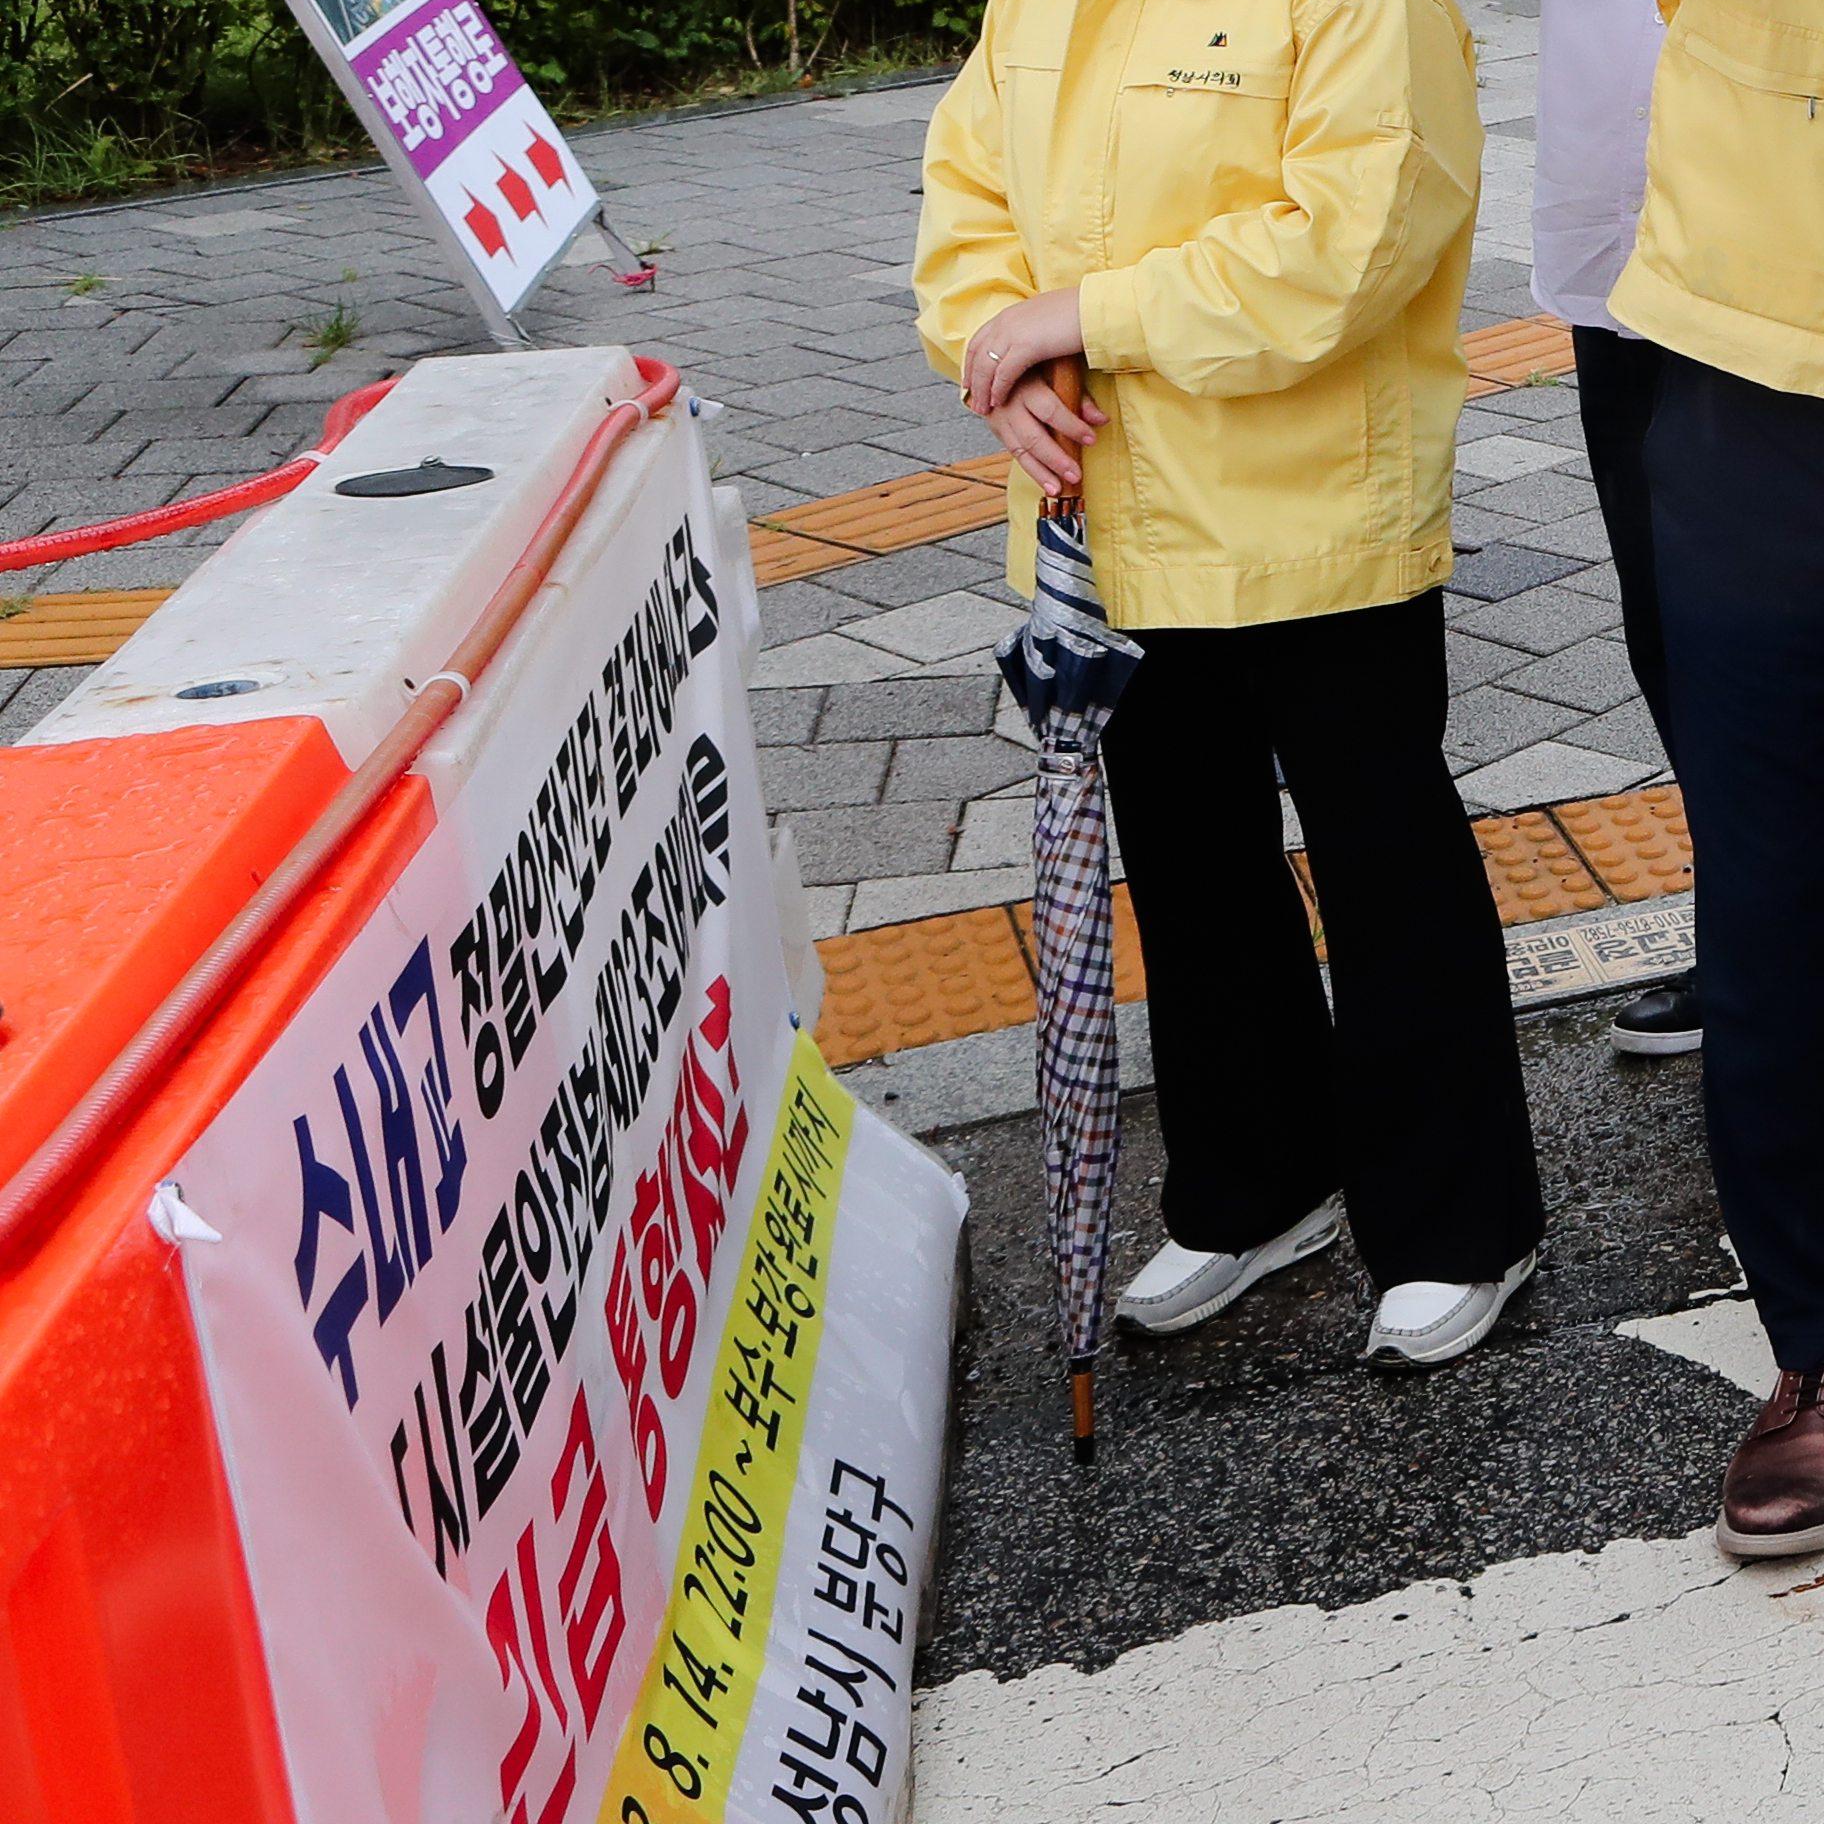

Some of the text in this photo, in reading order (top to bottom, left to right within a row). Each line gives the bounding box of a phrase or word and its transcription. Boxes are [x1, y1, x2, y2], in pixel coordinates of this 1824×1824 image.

[366, 0, 509, 152] 보행자통행로
[1167, 69, 1241, 87] 성남시의회
[1581, 910, 1682, 943] 010-8756-7582
[293, 934, 468, 1415] 수내교
[450, 690, 613, 1120] 정밀안전진단
[485, 1378, 627, 1824] 긴급
[683, 1469, 764, 1641] 22:00
[663, 1630, 735, 1730] 14.
[771, 1457, 915, 1824] 성남시 분당구
[643, 1722, 710, 1801] 8.
